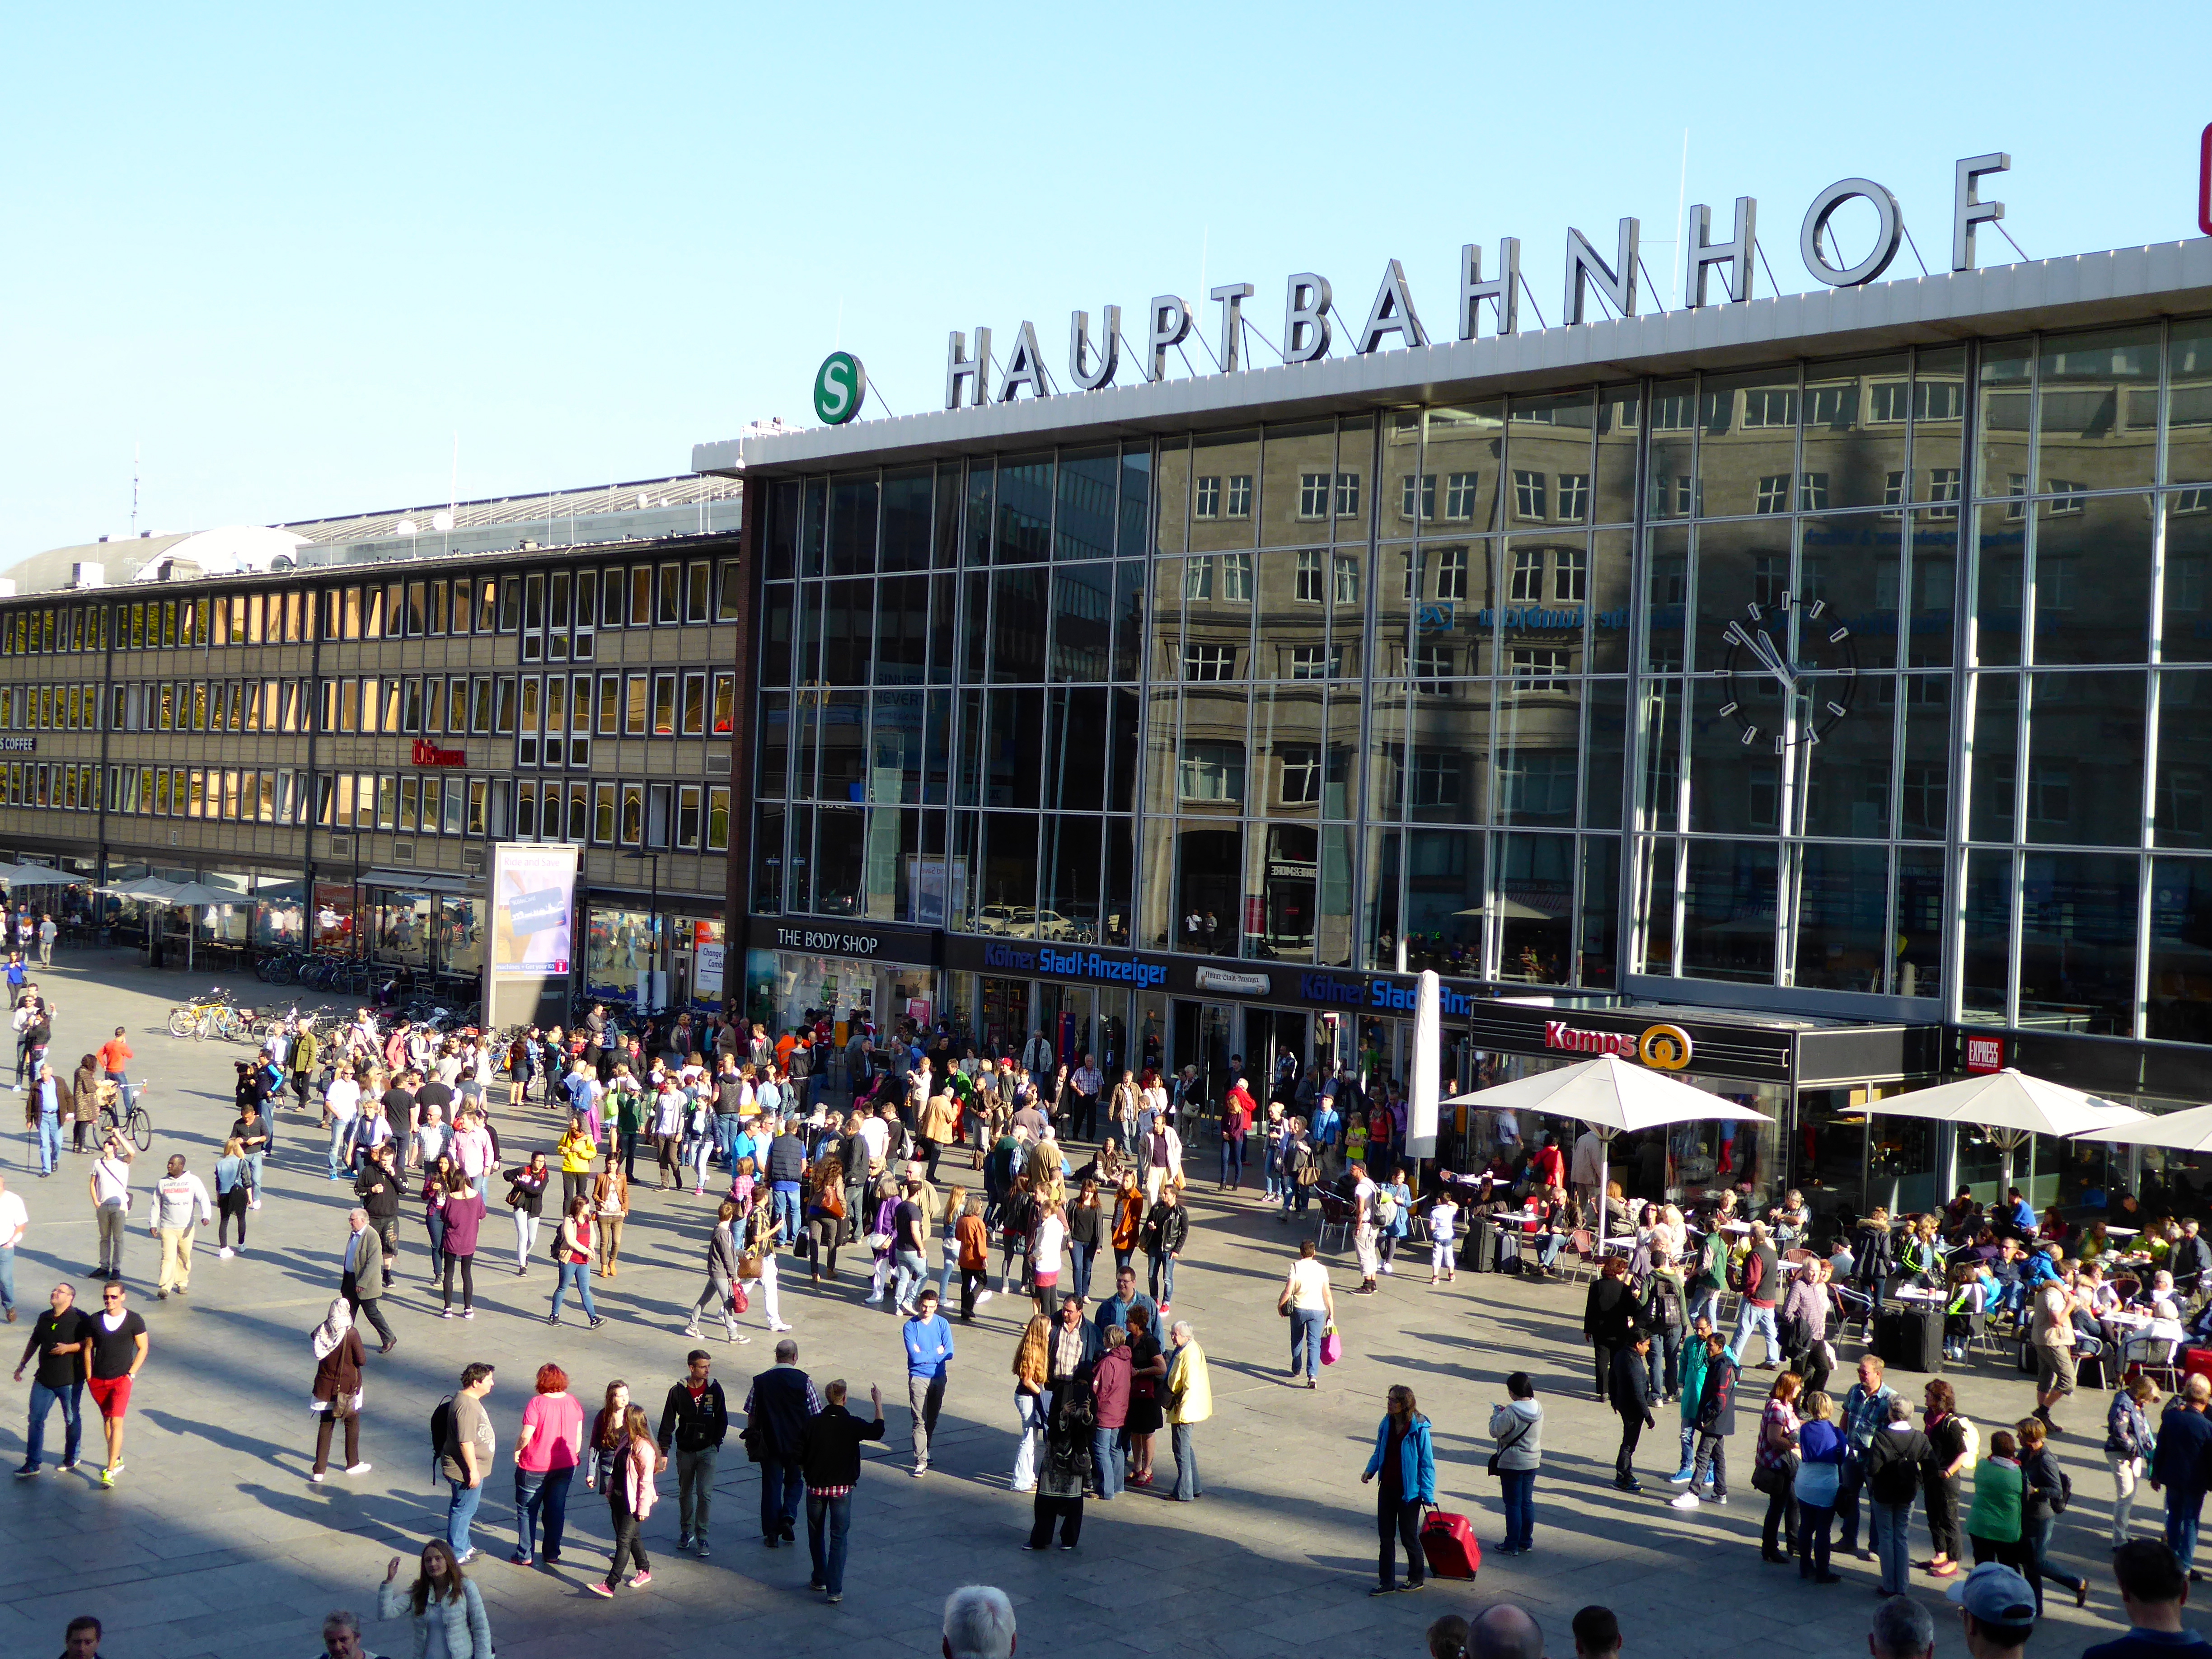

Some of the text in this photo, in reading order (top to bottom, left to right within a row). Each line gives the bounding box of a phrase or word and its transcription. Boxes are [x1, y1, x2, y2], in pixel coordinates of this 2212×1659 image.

[945, 151, 2011, 409] HAUPTBAHNHOF
[822, 360, 849, 415] S
[5, 737, 33, 750] COFFEE
[504, 857, 522, 866] Ride
[524, 858, 539, 866] and
[703, 948, 722, 959] Change
[778, 928, 878, 954] THE BODY SHOP
[984, 942, 1168, 988] Kölner Stadt-Anzeiger
[1300, 973, 1367, 1005] Kölner
[1545, 1021, 1637, 1057] Kamps
[1969, 1040, 1999, 1064] EXPRESS
